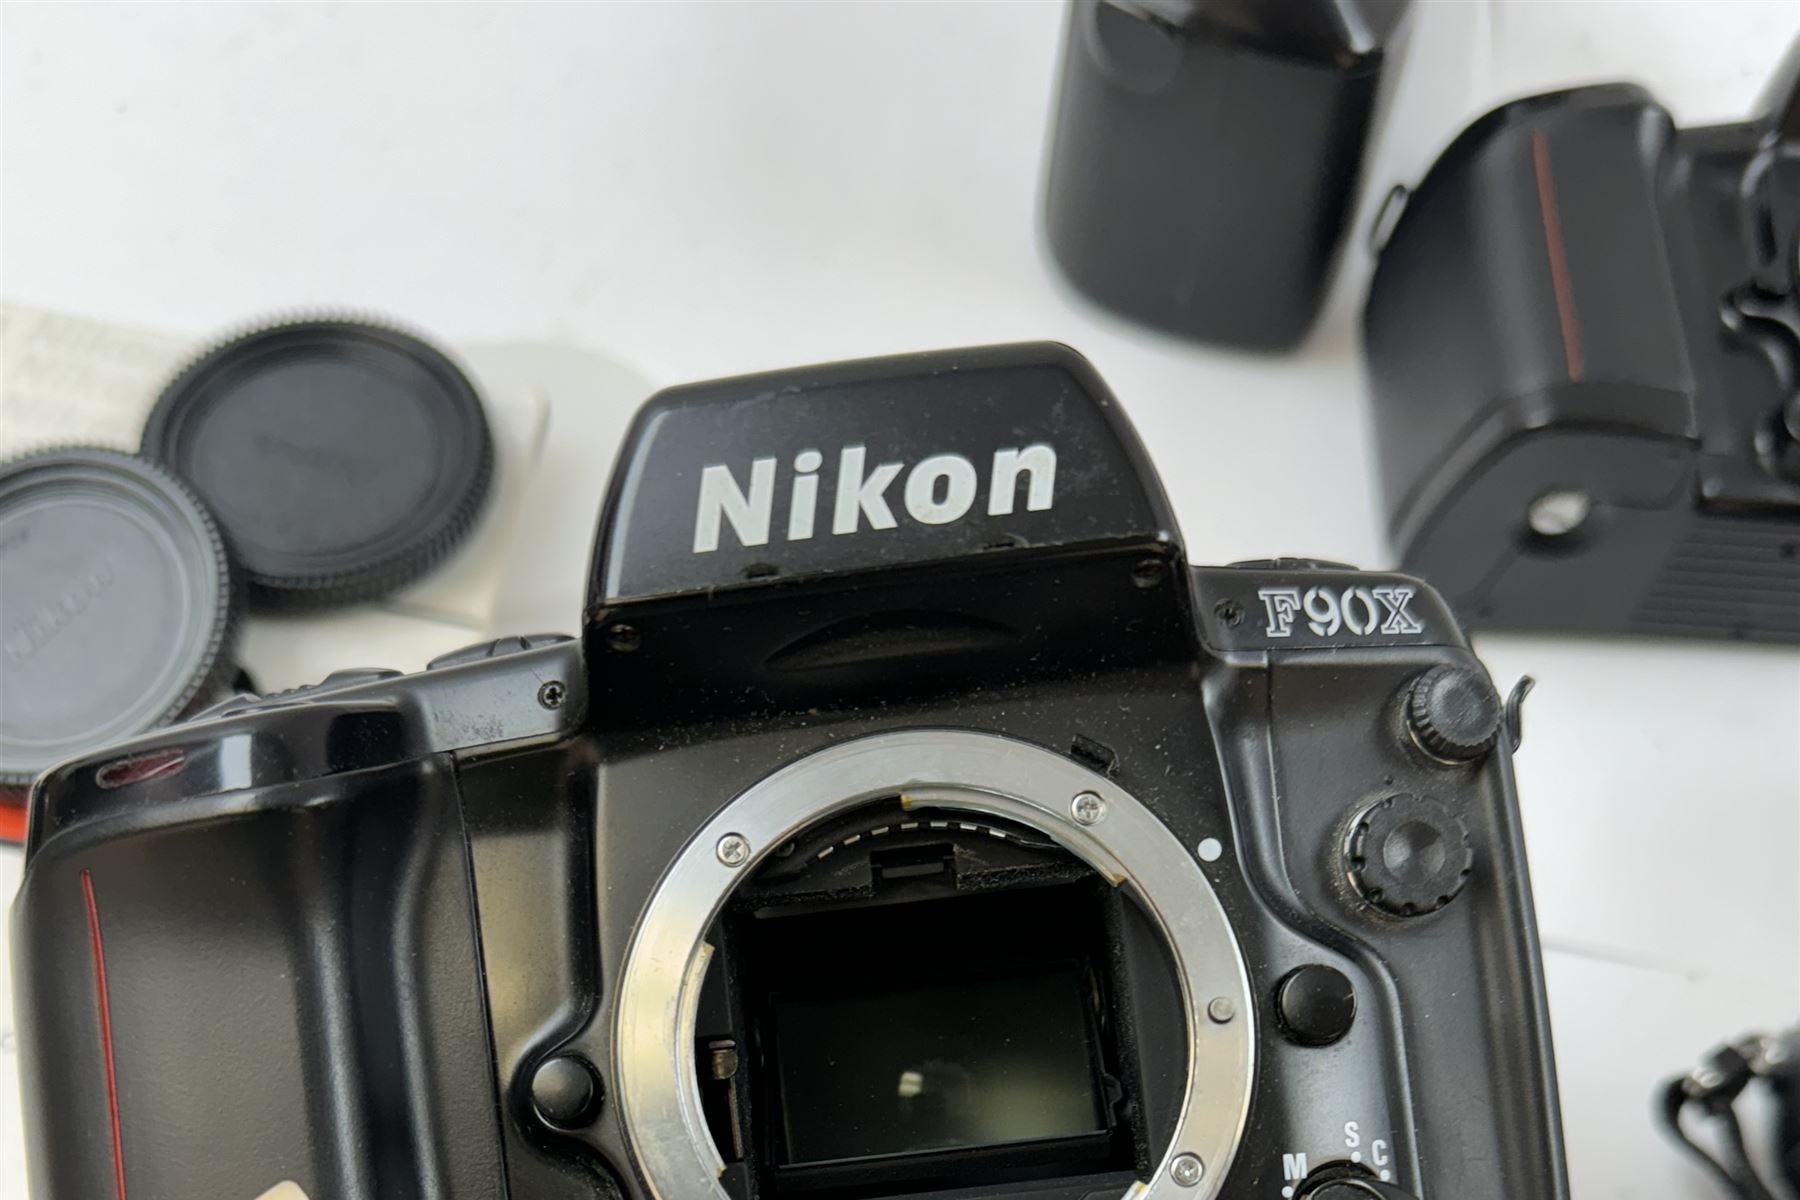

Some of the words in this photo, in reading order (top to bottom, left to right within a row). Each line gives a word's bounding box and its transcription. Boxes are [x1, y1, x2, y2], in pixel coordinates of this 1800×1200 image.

[693, 444, 1057, 554] Nikon
[1258, 586, 1424, 638] F90X
[1343, 1120, 1360, 1148] S
[1282, 1152, 1308, 1181] M
[1371, 1139, 1389, 1167] C
